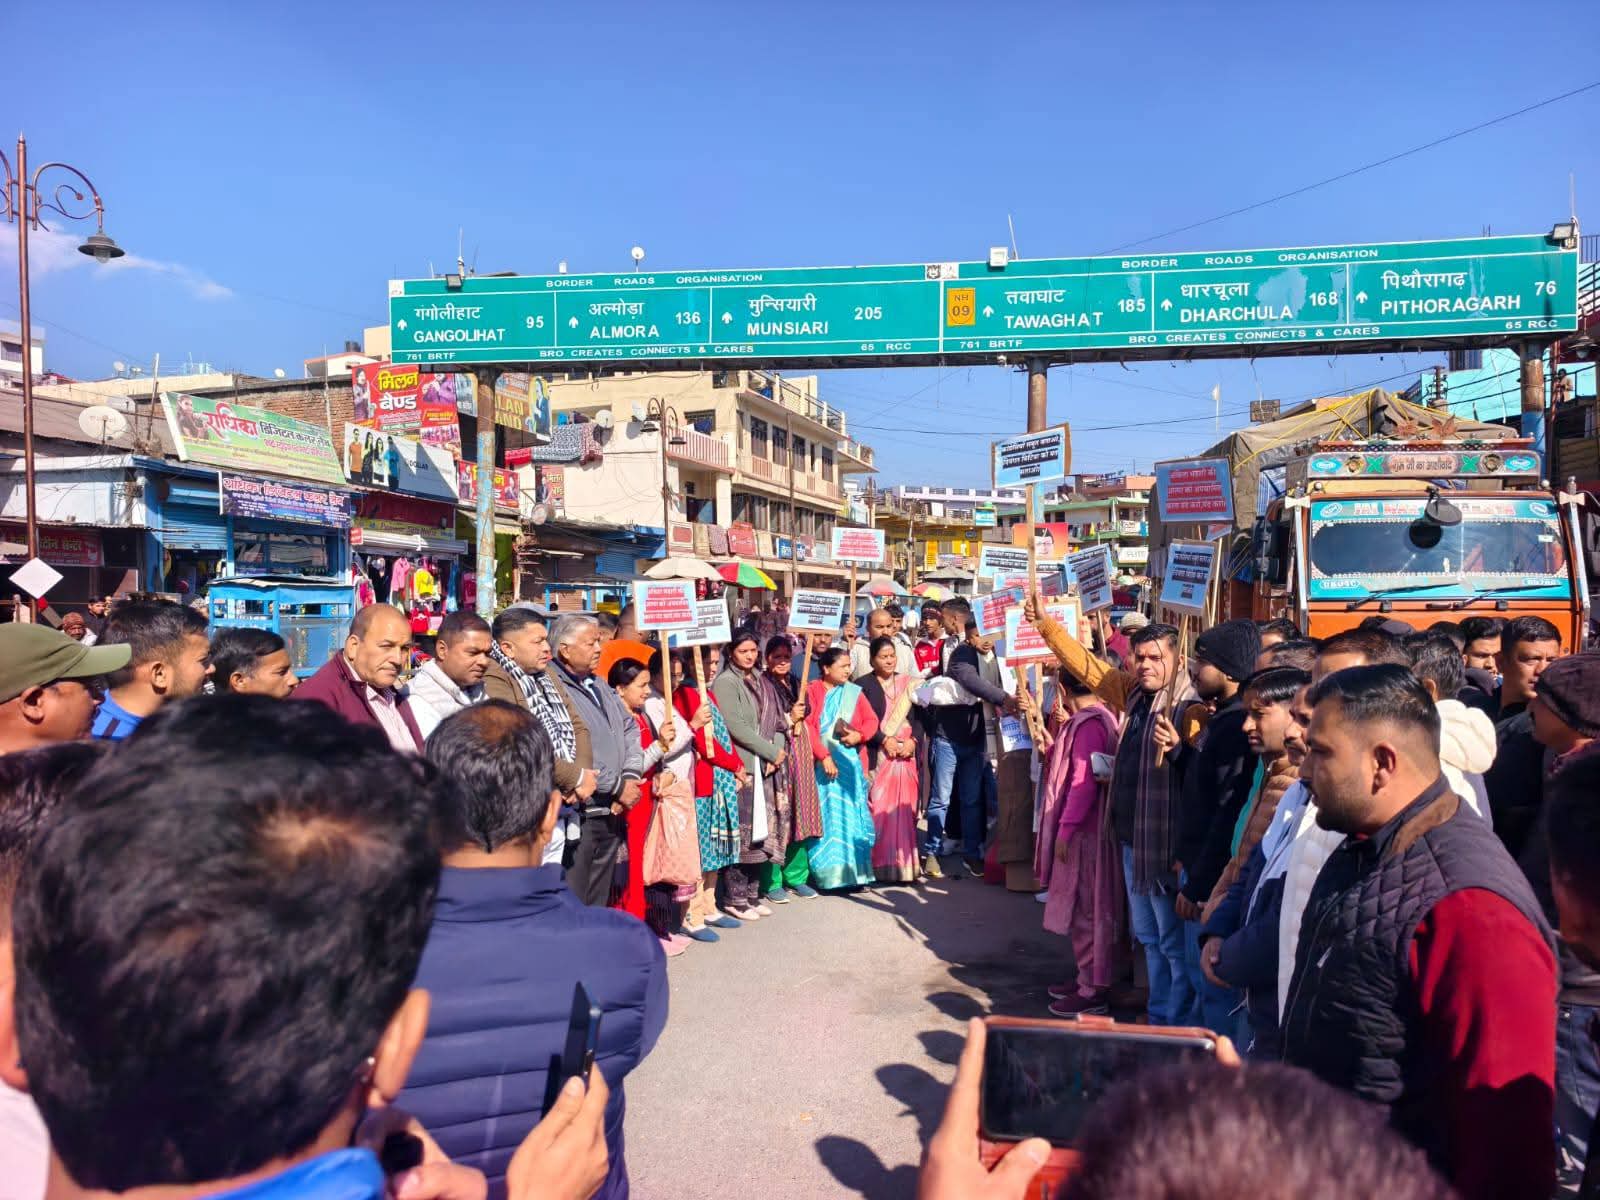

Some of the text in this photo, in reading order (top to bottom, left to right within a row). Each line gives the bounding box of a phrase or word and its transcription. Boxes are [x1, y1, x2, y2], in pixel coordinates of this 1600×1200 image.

[1121, 249, 1379, 269] BORDER ROADS ORGANISATION
[545, 273, 764, 288] BORDER ROADS ORGANISATION
[1380, 269, 1469, 291] पिथौरागढ़
[1533, 280, 1558, 296] 76
[953, 294, 970, 303] NH
[1005, 289, 1066, 305] तवाघाट
[1180, 281, 1251, 303] धारचूला
[1308, 291, 1339, 307] 168
[414, 302, 483, 321] गंगोलीहाट
[588, 298, 645, 319] अल्मोड़ा
[748, 292, 818, 317] मुन्सियारी
[952, 304, 971, 317] 09
[1118, 298, 1147, 313] 185
[1380, 293, 1522, 316] PITHORAGARH
[674, 310, 702, 325] 136
[854, 306, 883, 321] 205
[1004, 312, 1105, 329] TAWAGHAT
[1179, 304, 1294, 323] DHARCHULA
[525, 315, 545, 329] 95
[746, 321, 829, 336] MUNSIARI
[1504, 318, 1559, 330] 65 RCC
[413, 328, 506, 343] GANGOLIHAT
[589, 325, 660, 339] ALMORA
[1128, 326, 1381, 344] BRO CREATES CONNECTS & CARES
[538, 343, 755, 359] BRO CREATES CONNECTS & CARES
[859, 340, 912, 351] 65 RCC
[959, 338, 1024, 350] 761 BRTF
[405, 351, 457, 361] 761 BRTF
[378, 370, 418, 391] मिलन
[201, 402, 259, 440] राधिका
